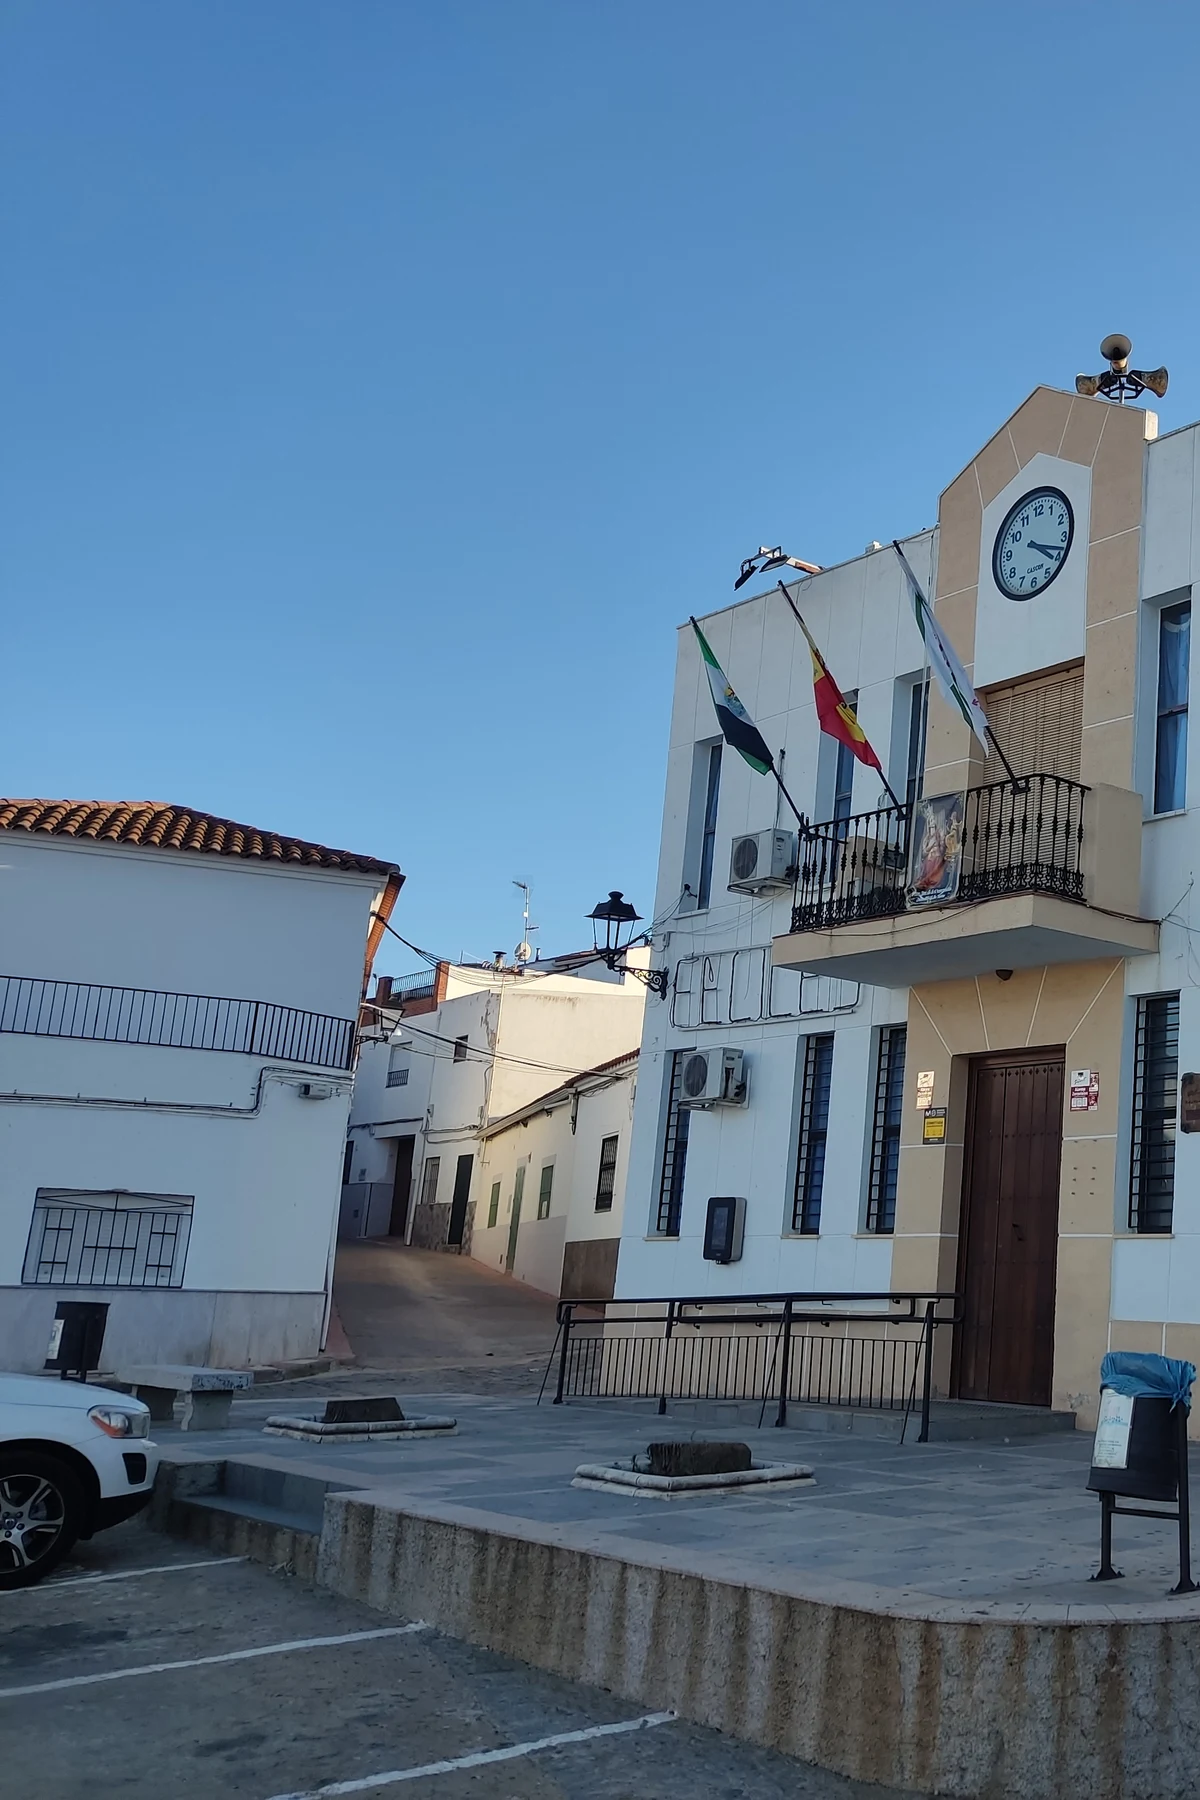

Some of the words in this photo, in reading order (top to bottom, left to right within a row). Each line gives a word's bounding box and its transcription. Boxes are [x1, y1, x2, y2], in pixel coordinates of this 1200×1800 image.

[1033, 504, 1044, 517] 12
[1048, 504, 1054, 516] 1
[1020, 514, 1030, 528] 11
[1057, 514, 1064, 526] 2
[1010, 530, 1022, 544] 10
[1060, 530, 1068, 542] 3
[1005, 550, 1013, 562] 9
[1054, 551, 1061, 562] 4
[1009, 567, 1016, 578] 8
[1043, 567, 1051, 579] 5
[1019, 576, 1026, 588] 7
[1030, 577, 1038, 588] 6
